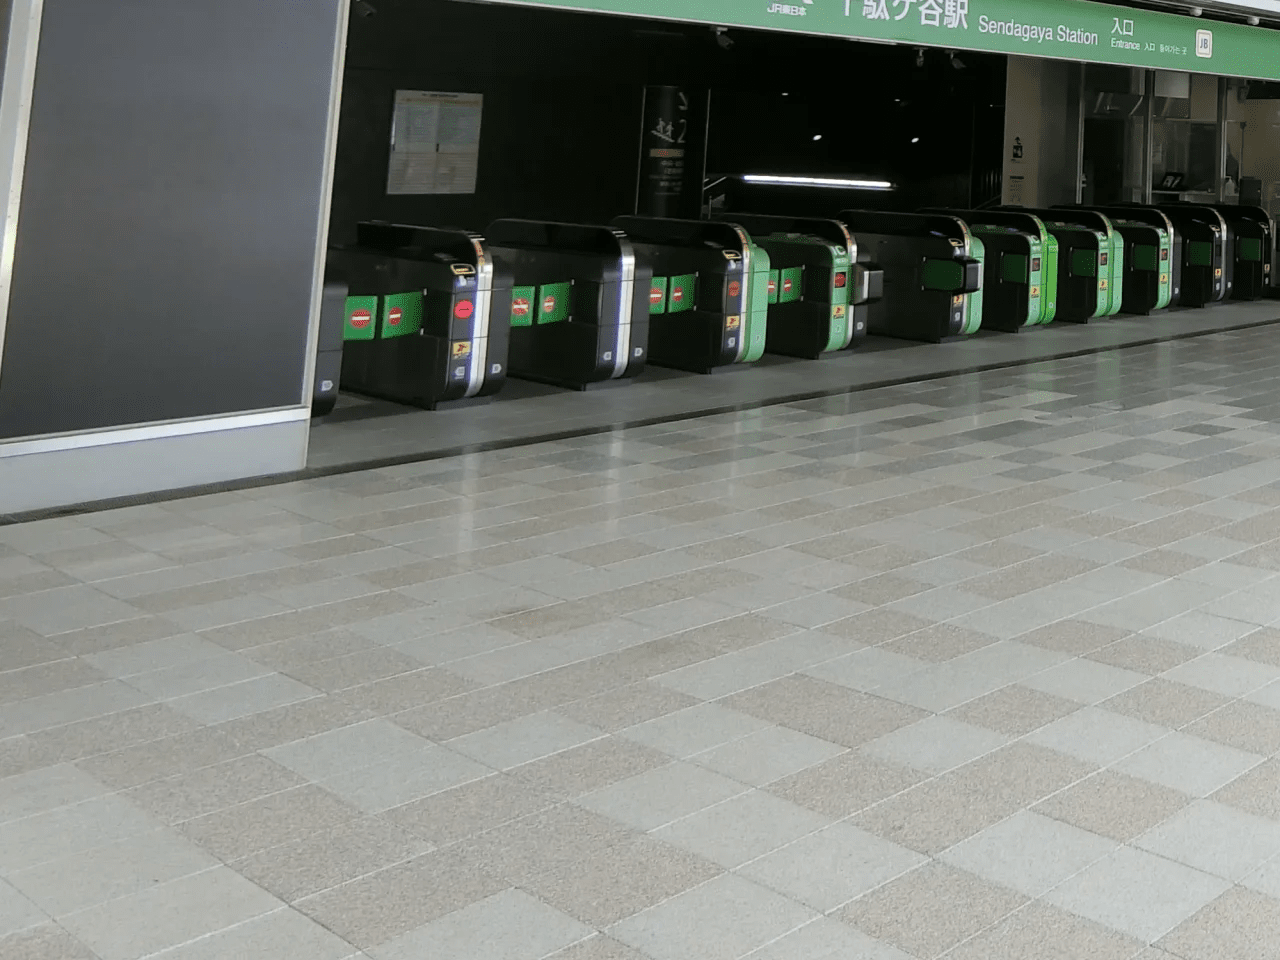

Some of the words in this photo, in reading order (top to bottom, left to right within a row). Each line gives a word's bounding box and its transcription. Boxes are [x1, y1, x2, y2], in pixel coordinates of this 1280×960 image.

[767, 2, 807, 16] JR東日本
[978, 14, 1053, 44] Sendagaya
[1056, 24, 1099, 46] Station
[1111, 17, 1134, 36] 入口
[1110, 37, 1141, 51] Entrance
[1143, 42, 1155, 52] 入口
[1199, 38, 1209, 50] JB
